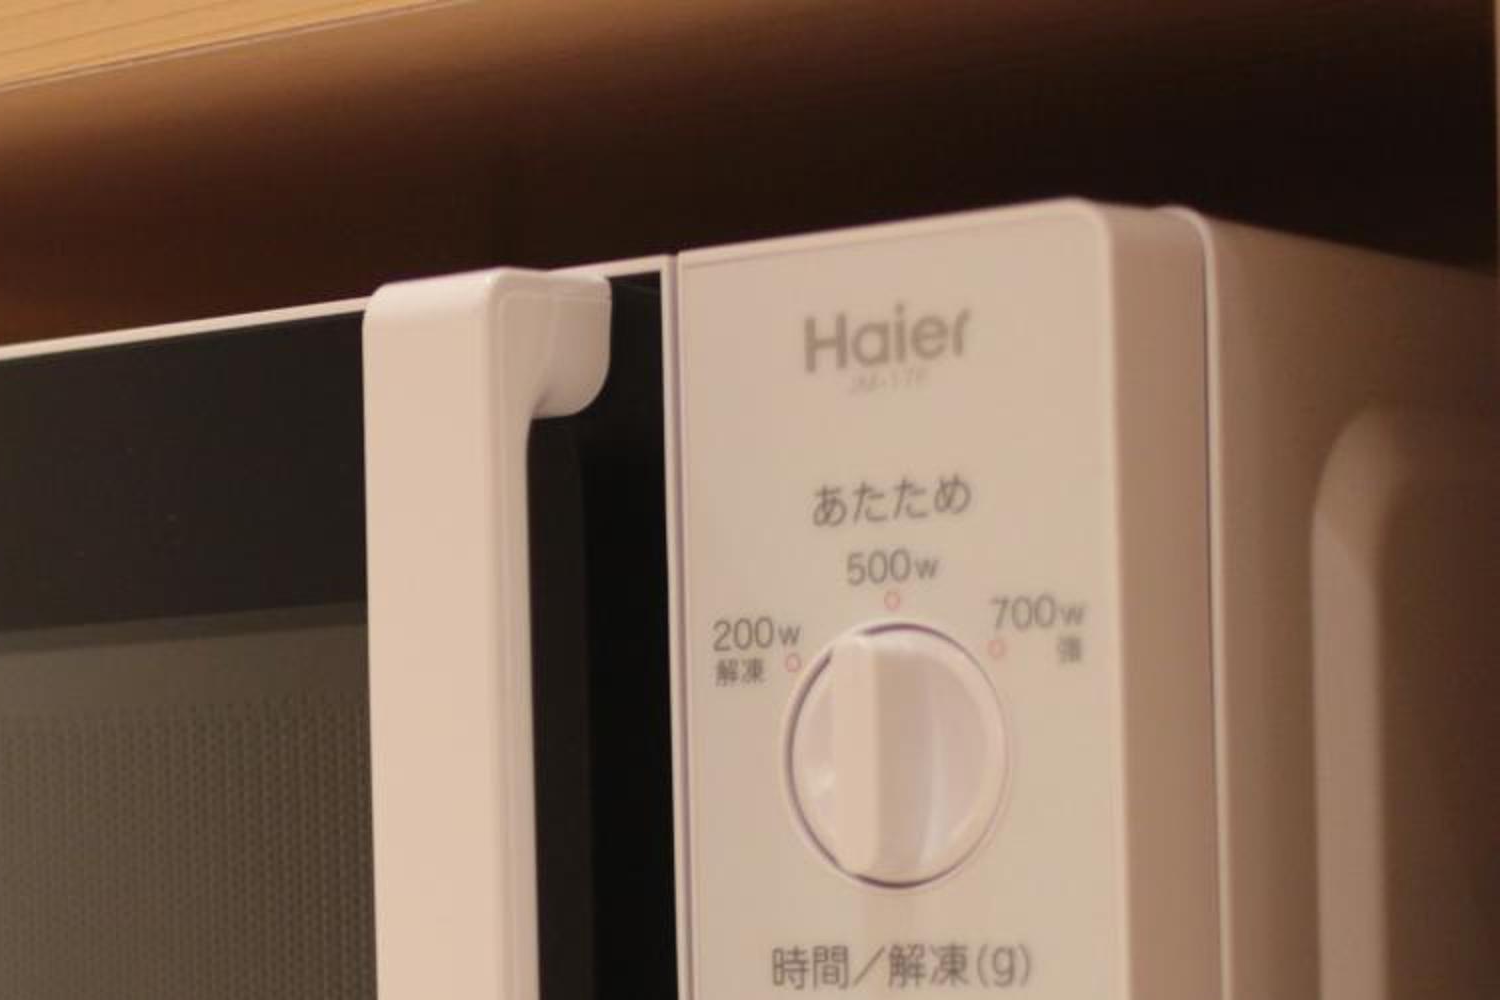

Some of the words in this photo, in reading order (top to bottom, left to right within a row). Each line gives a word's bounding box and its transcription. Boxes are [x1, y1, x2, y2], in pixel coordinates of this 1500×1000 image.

[803, 300, 971, 373] Haier
[812, 473, 973, 528] あたため
[715, 658, 765, 687] 解凍
